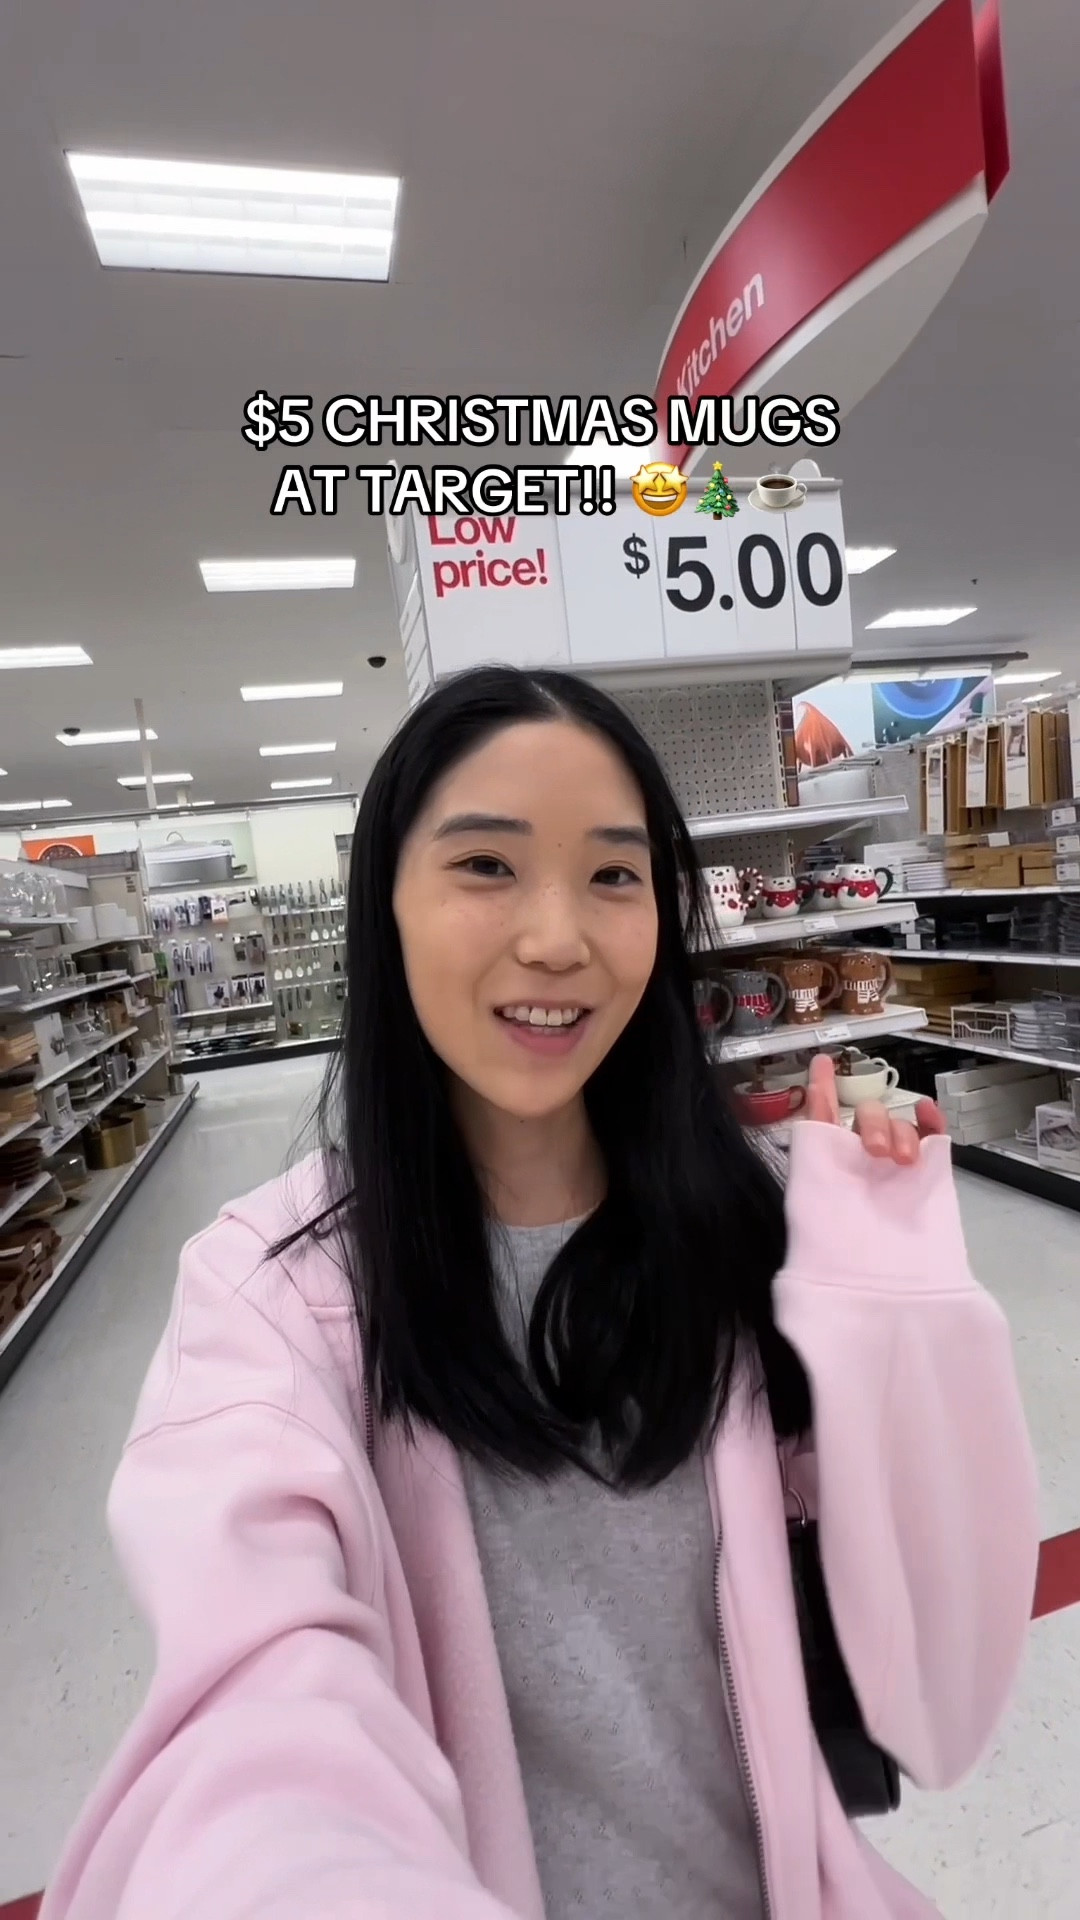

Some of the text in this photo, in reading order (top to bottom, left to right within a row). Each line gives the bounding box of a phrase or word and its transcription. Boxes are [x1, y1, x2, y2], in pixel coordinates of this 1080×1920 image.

[676, 273, 765, 399] Kitchen
[427, 515, 516, 545] Low
[433, 548, 548, 598] price!
